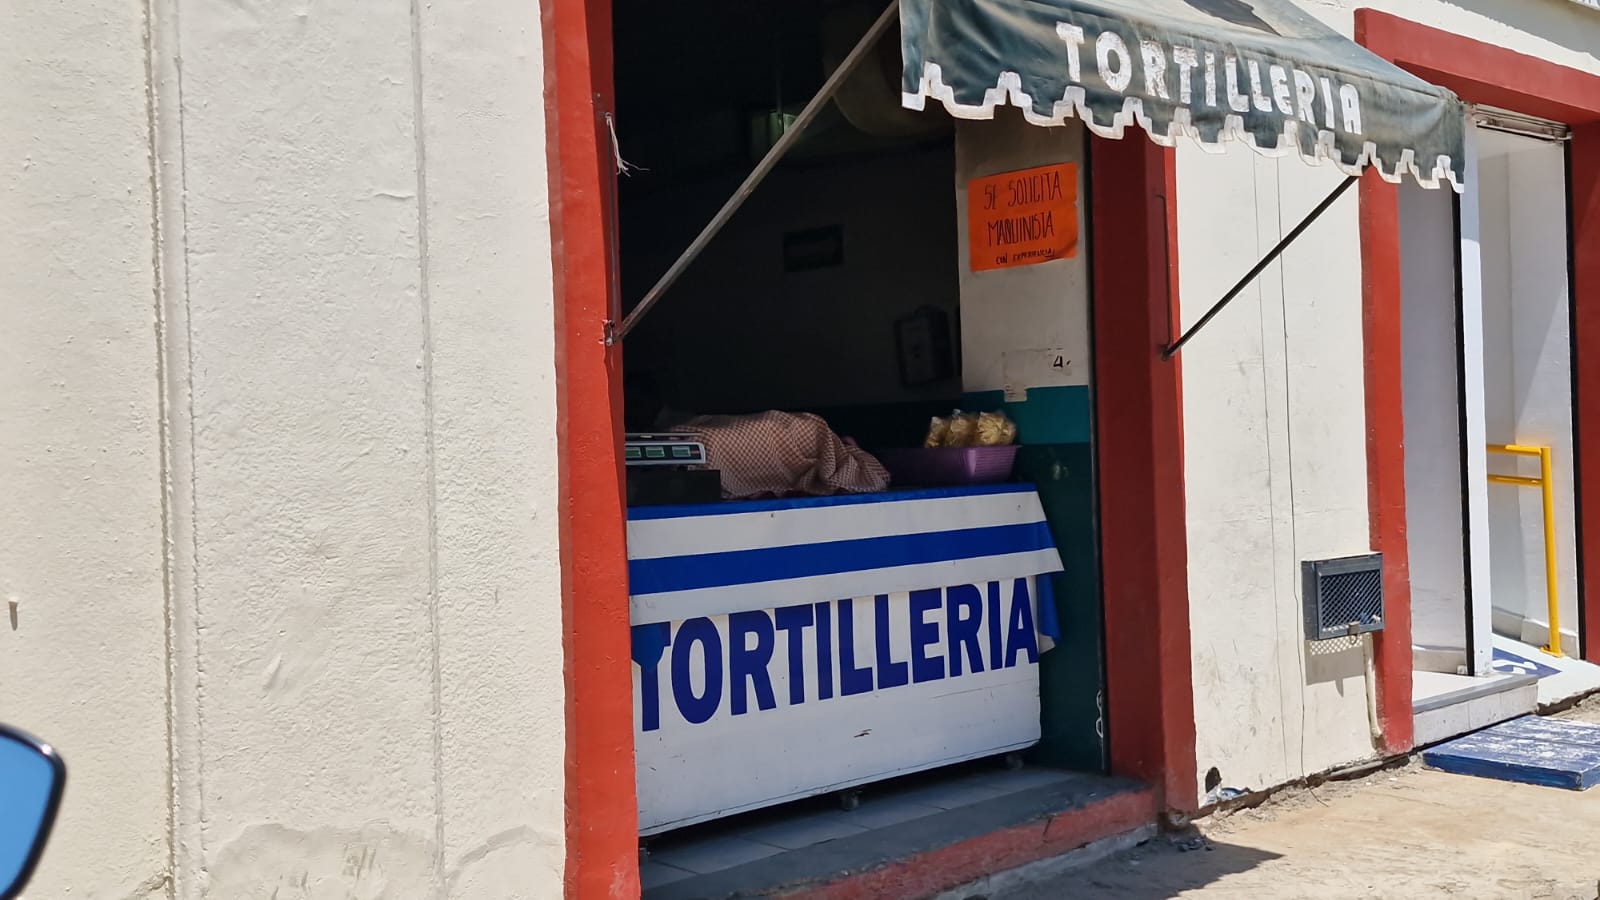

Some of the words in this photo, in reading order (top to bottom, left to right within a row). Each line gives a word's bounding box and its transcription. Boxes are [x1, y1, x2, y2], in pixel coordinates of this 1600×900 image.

[1056, 21, 1363, 136] TORTILLERIA
[984, 184, 998, 210] SE
[1008, 170, 1062, 207] SOLICITA
[987, 210, 1054, 247] MAQUINISTA
[996, 252, 1008, 264] CON
[631, 577, 1039, 732] TORTILLERIA
